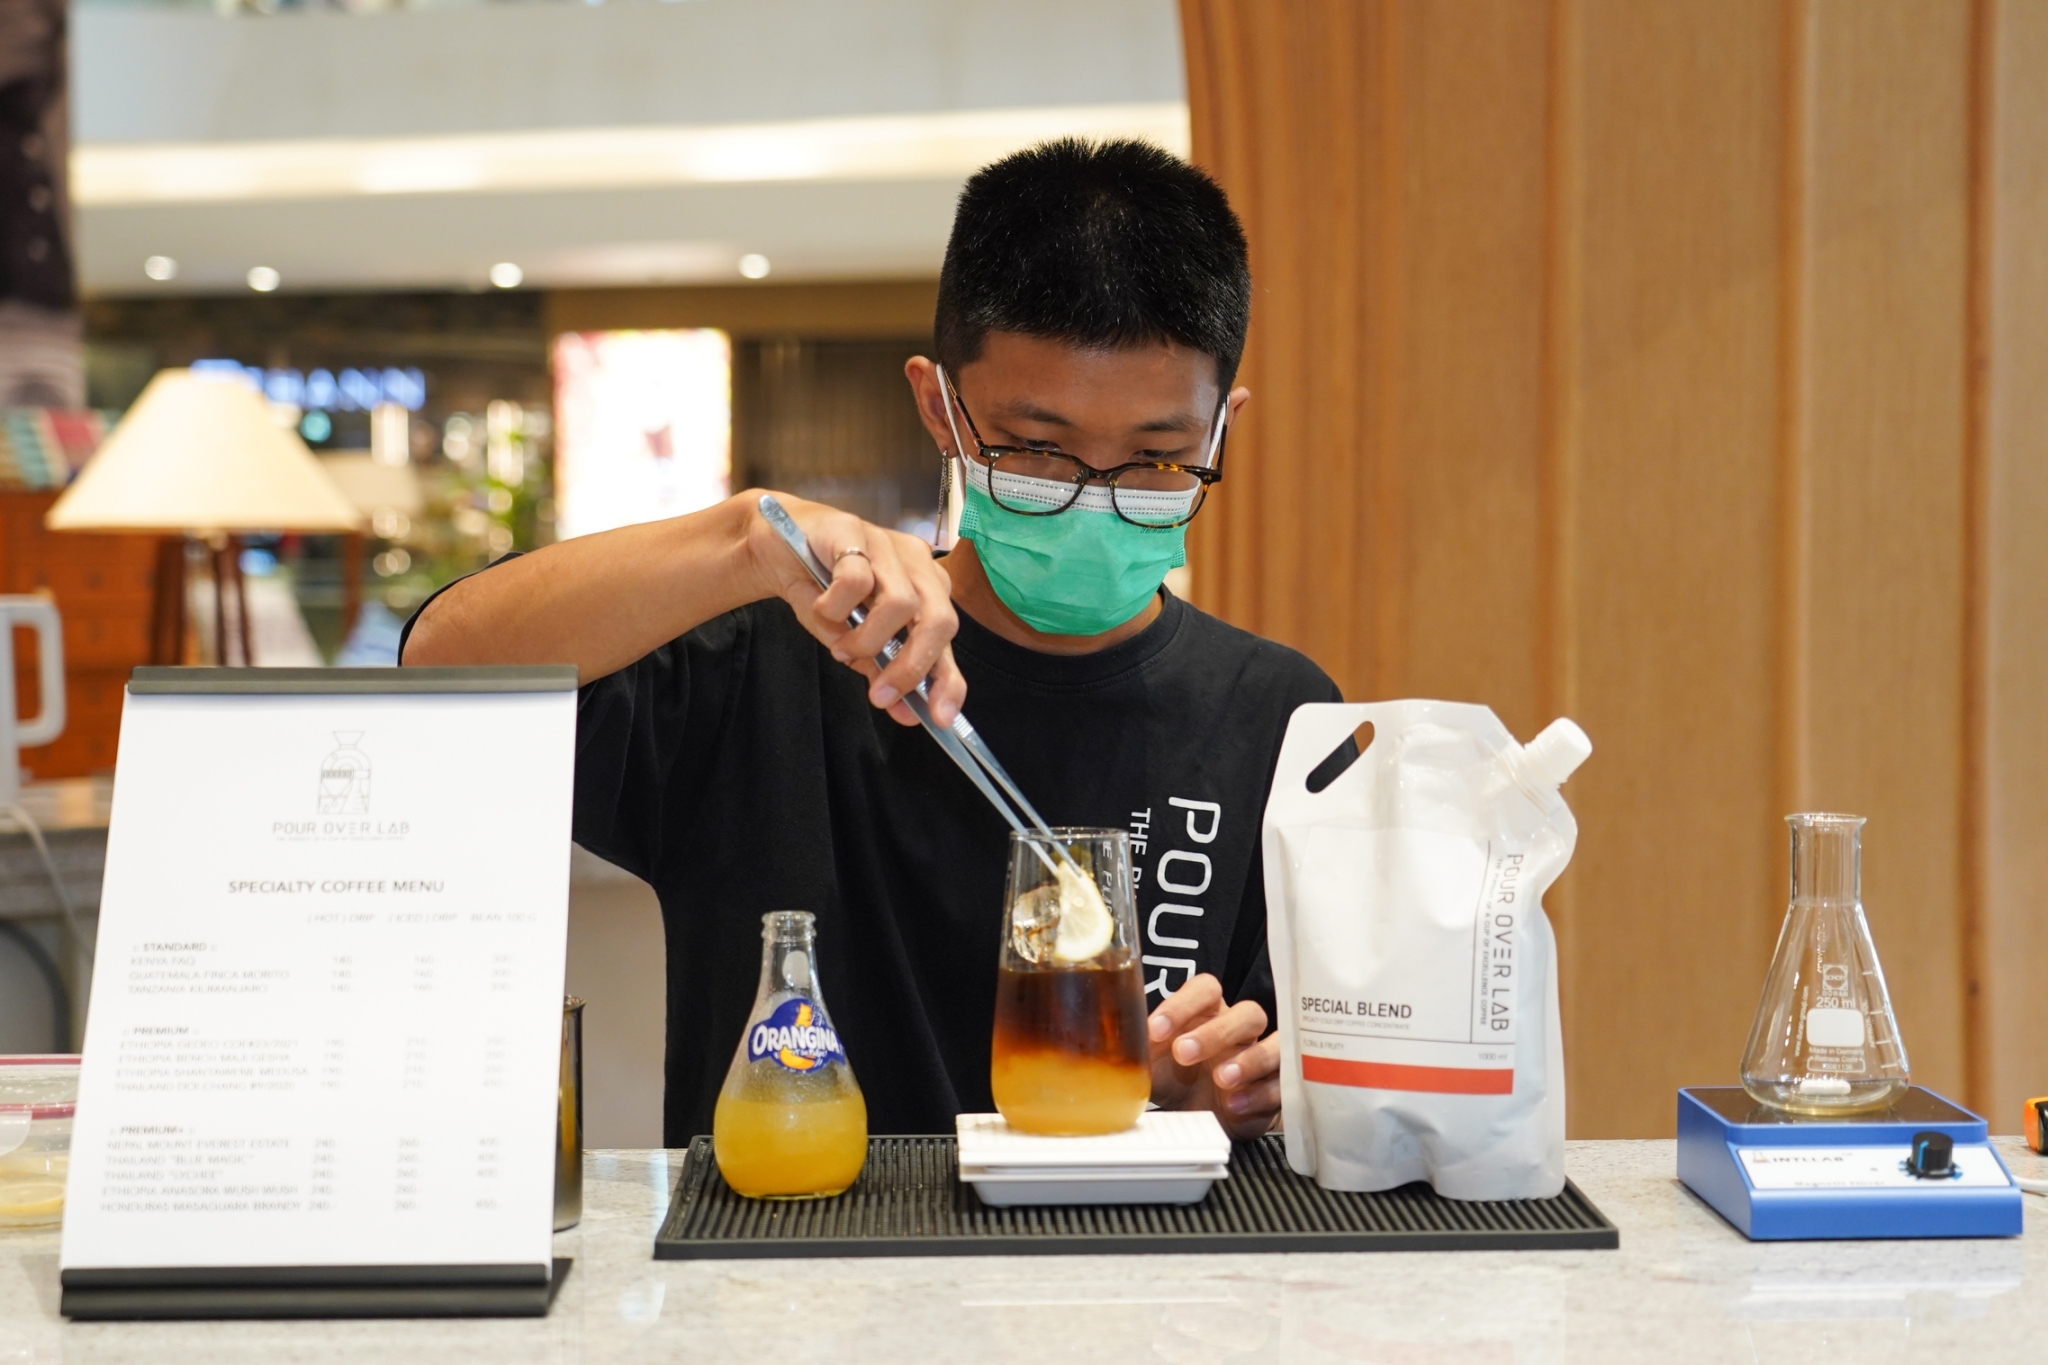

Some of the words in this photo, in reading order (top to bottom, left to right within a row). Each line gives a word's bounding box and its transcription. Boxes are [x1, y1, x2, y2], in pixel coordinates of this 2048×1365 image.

[273, 822, 317, 835] POUR
[323, 821, 371, 835] OVER
[378, 821, 411, 835] LAB
[1129, 807, 1151, 856] THE
[228, 880, 316, 894] SPECIALTY
[321, 880, 387, 894] COFFEE
[392, 880, 445, 893] MENU
[1497, 854, 1525, 904] POUR
[1142, 796, 1221, 999] POUR
[143, 942, 208, 952] STANDARD
[1493, 914, 1514, 978] OVER
[1480, 951, 1489, 996] EXCELLENCE
[1301, 996, 1353, 1016] SPECIAL
[1356, 1001, 1412, 1019] BLEND
[1479, 999, 1488, 1026] COFFEE
[1491, 988, 1511, 1032] LAB
[1816, 996, 1839, 1008] 250
[1841, 997, 1856, 1009] ml
[133, 1026, 190, 1035] PREMIUM
[752, 1023, 841, 1056] ORANGINA
